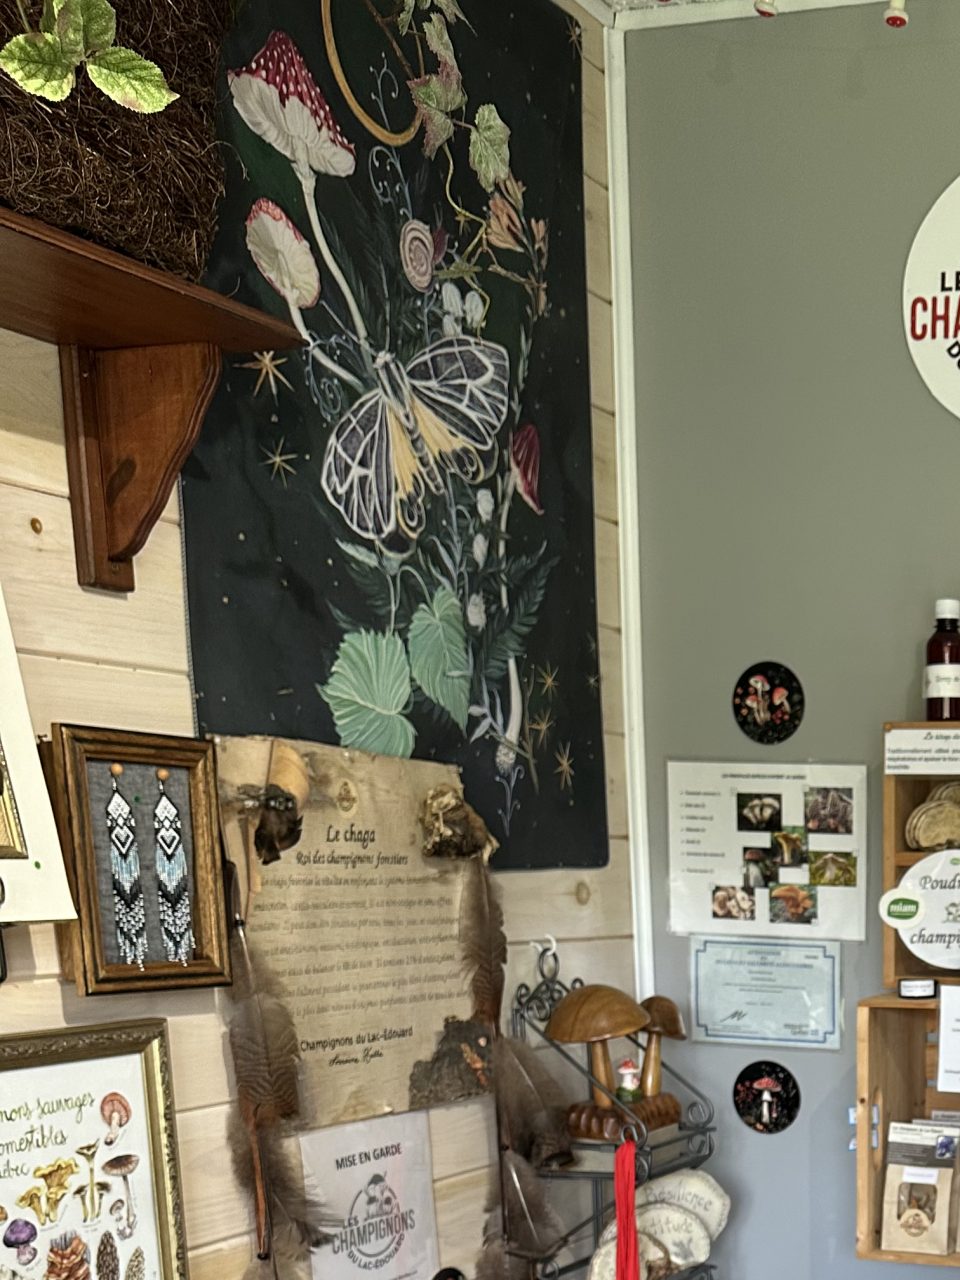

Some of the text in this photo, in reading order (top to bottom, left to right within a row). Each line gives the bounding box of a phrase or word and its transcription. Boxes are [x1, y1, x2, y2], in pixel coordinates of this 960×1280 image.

[326, 823, 376, 849] Le chaga
[296, 850, 312, 866] Roi
[313, 850, 325, 865] des
[327, 850, 374, 869] champignons
[300, 1037, 353, 1052] Champignons
[0, 1124, 68, 1156] omestibles
[336, 1143, 402, 1170] MISE EN GARDE
[332, 1208, 416, 1255] CHAMPIGNONS
